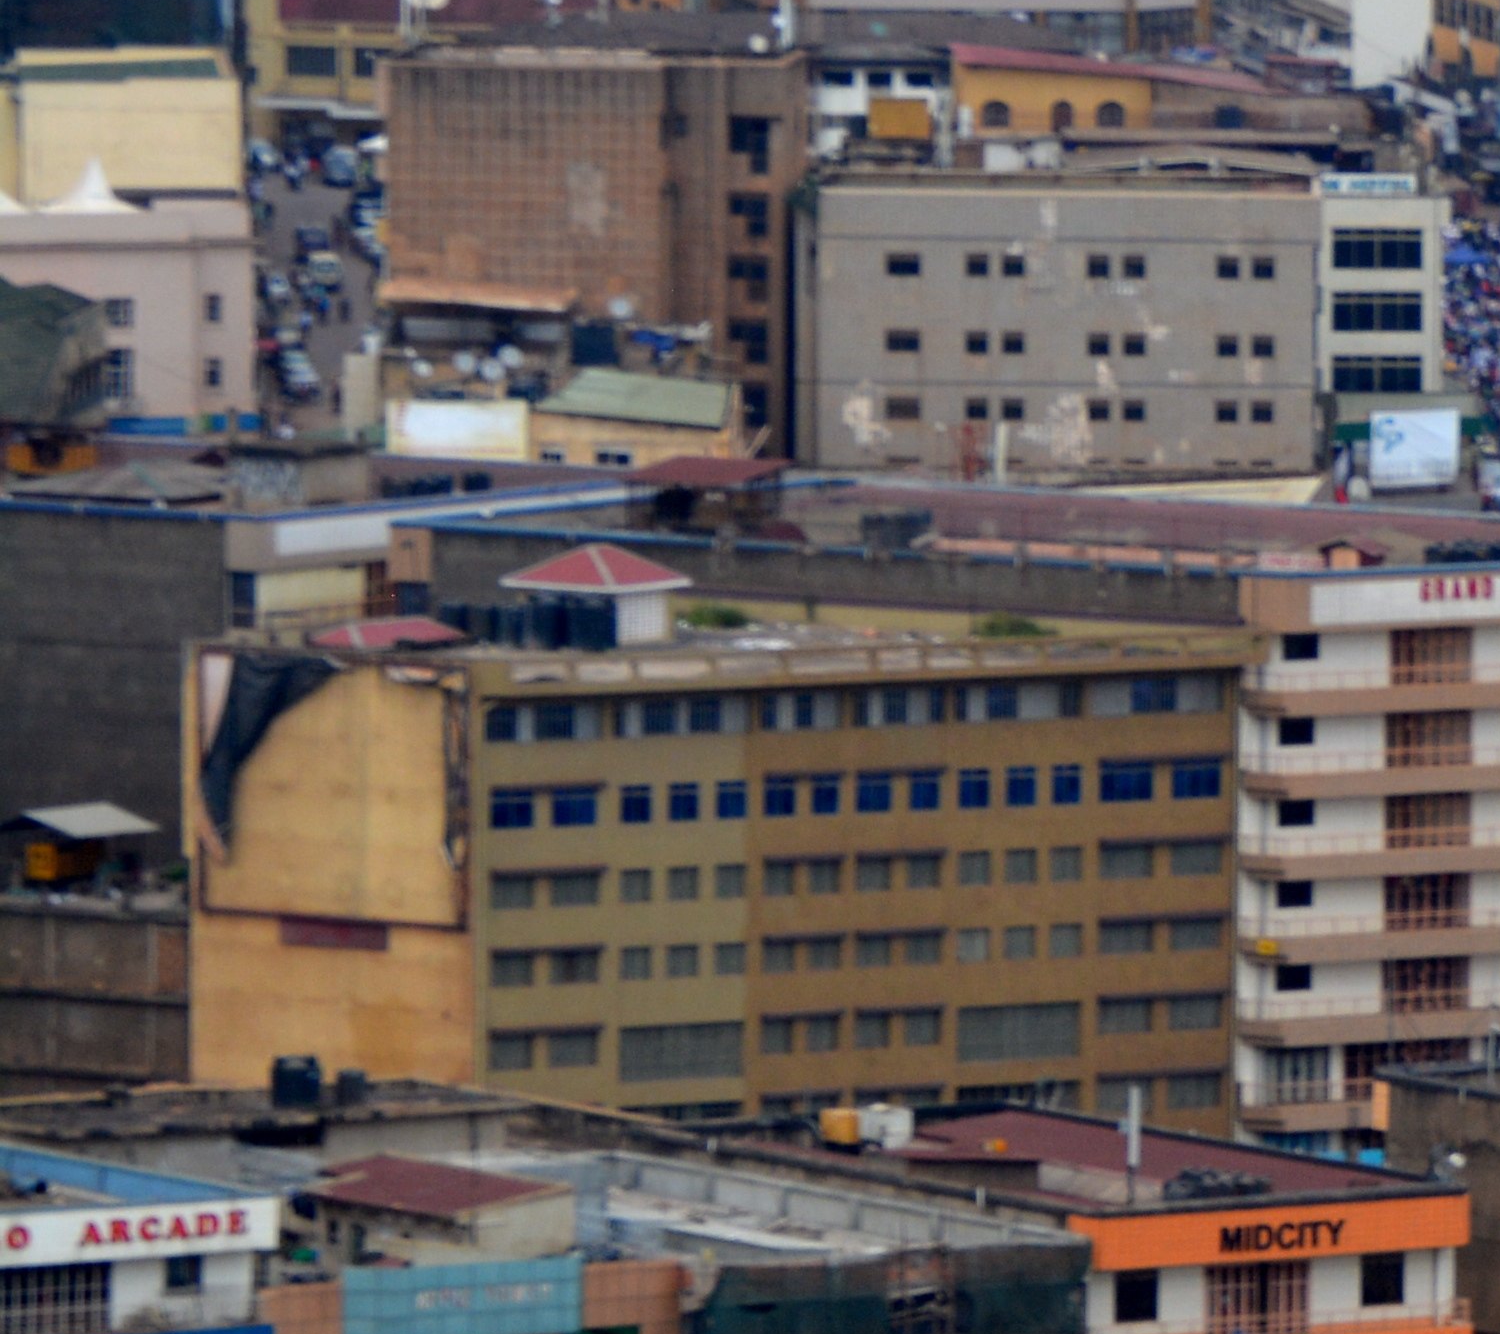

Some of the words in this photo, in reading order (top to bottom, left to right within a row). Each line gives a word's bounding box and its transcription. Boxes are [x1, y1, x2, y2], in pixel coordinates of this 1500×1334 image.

[1419, 575, 1496, 603] GRAND
[80, 1211, 249, 1246] ARCADE
[1220, 1219, 1345, 1254] MIDCITY
